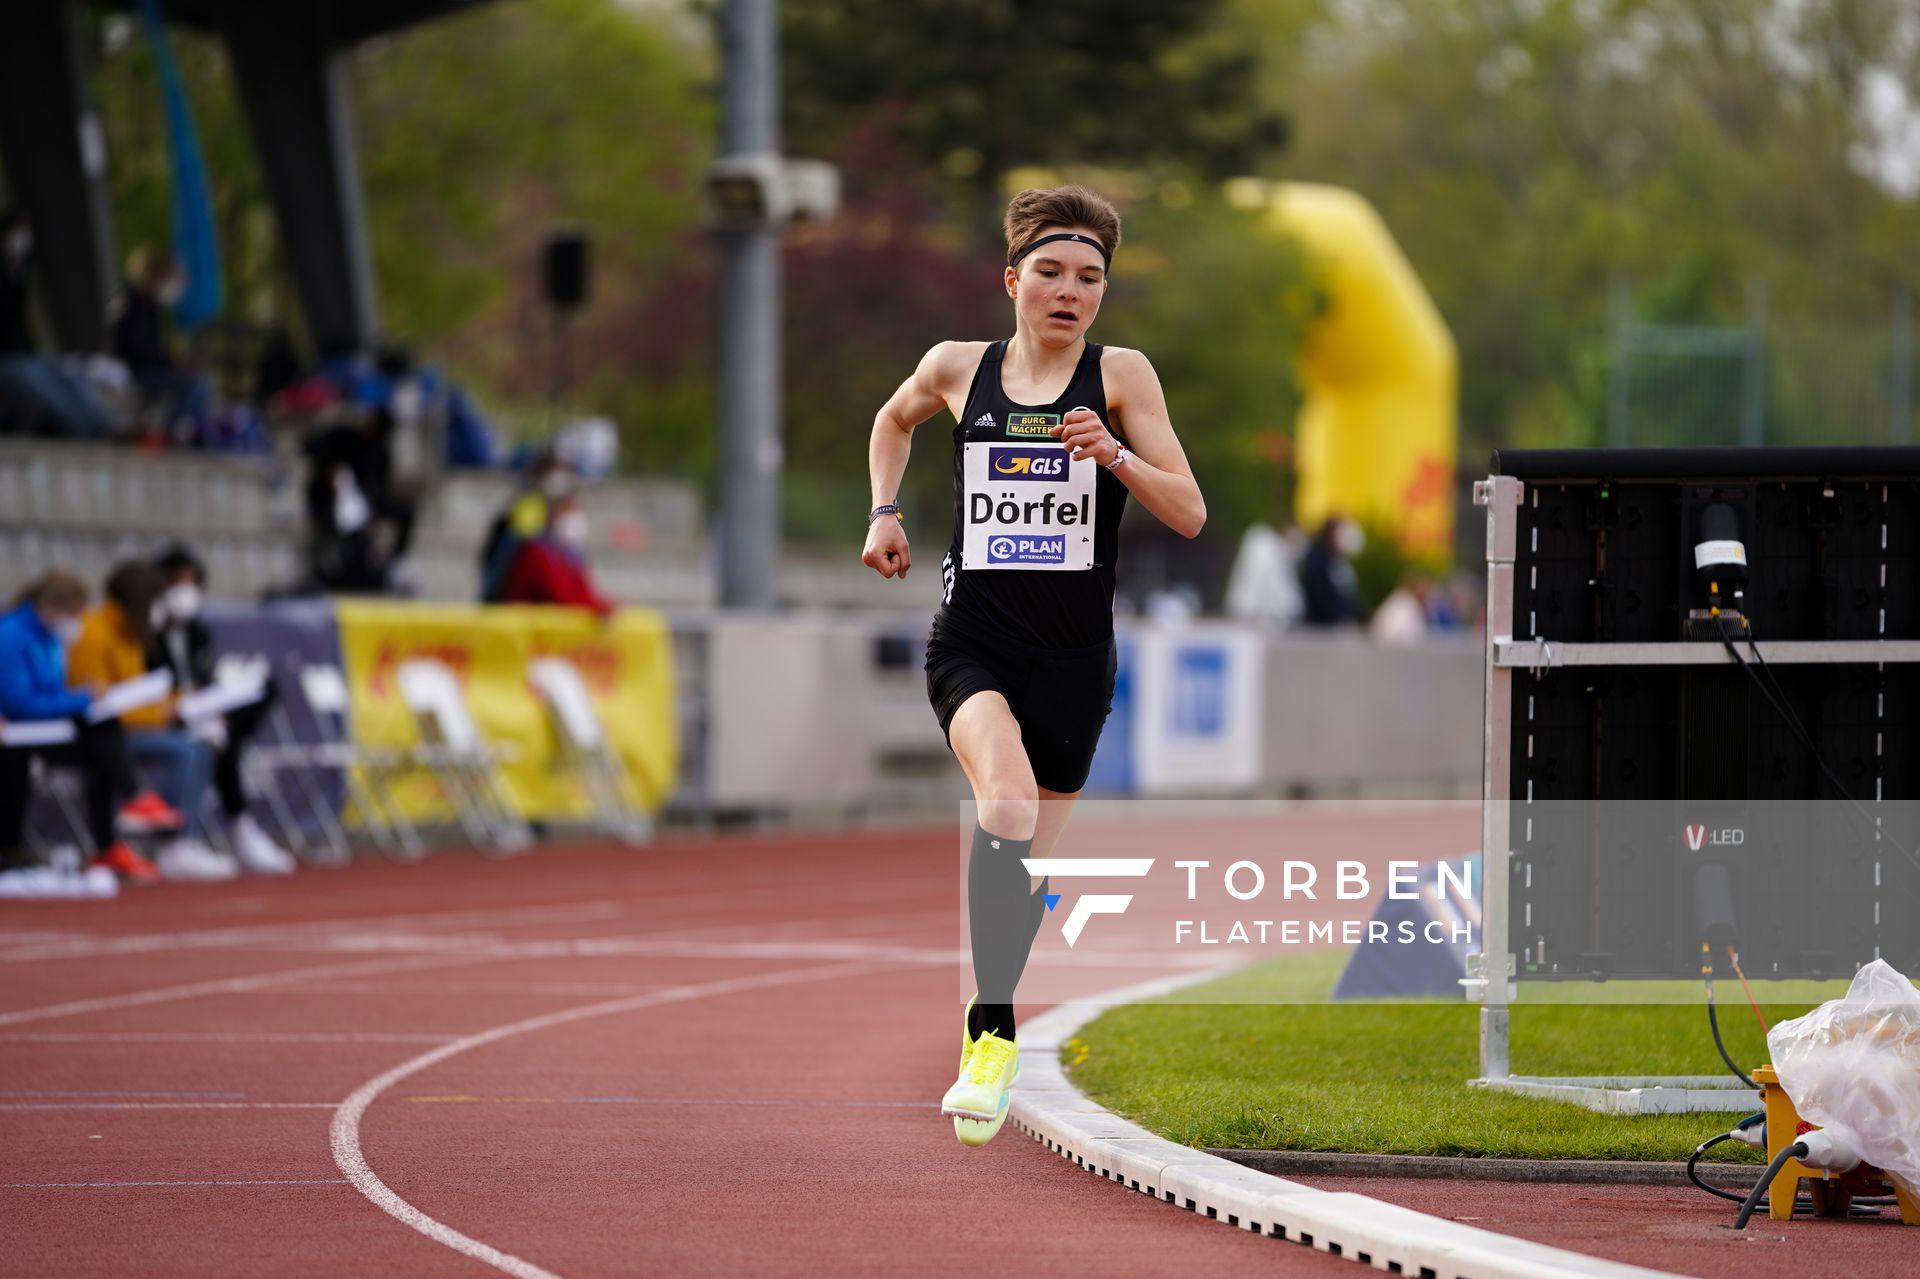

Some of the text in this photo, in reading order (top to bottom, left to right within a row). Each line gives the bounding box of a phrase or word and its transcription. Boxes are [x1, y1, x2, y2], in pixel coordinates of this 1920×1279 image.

[974, 420, 997, 428] adidas
[1021, 416, 1046, 425] BURG
[1030, 457, 1063, 475] GLS
[970, 492, 1090, 526] Dörfel
[1019, 540, 1062, 554] PLAN
